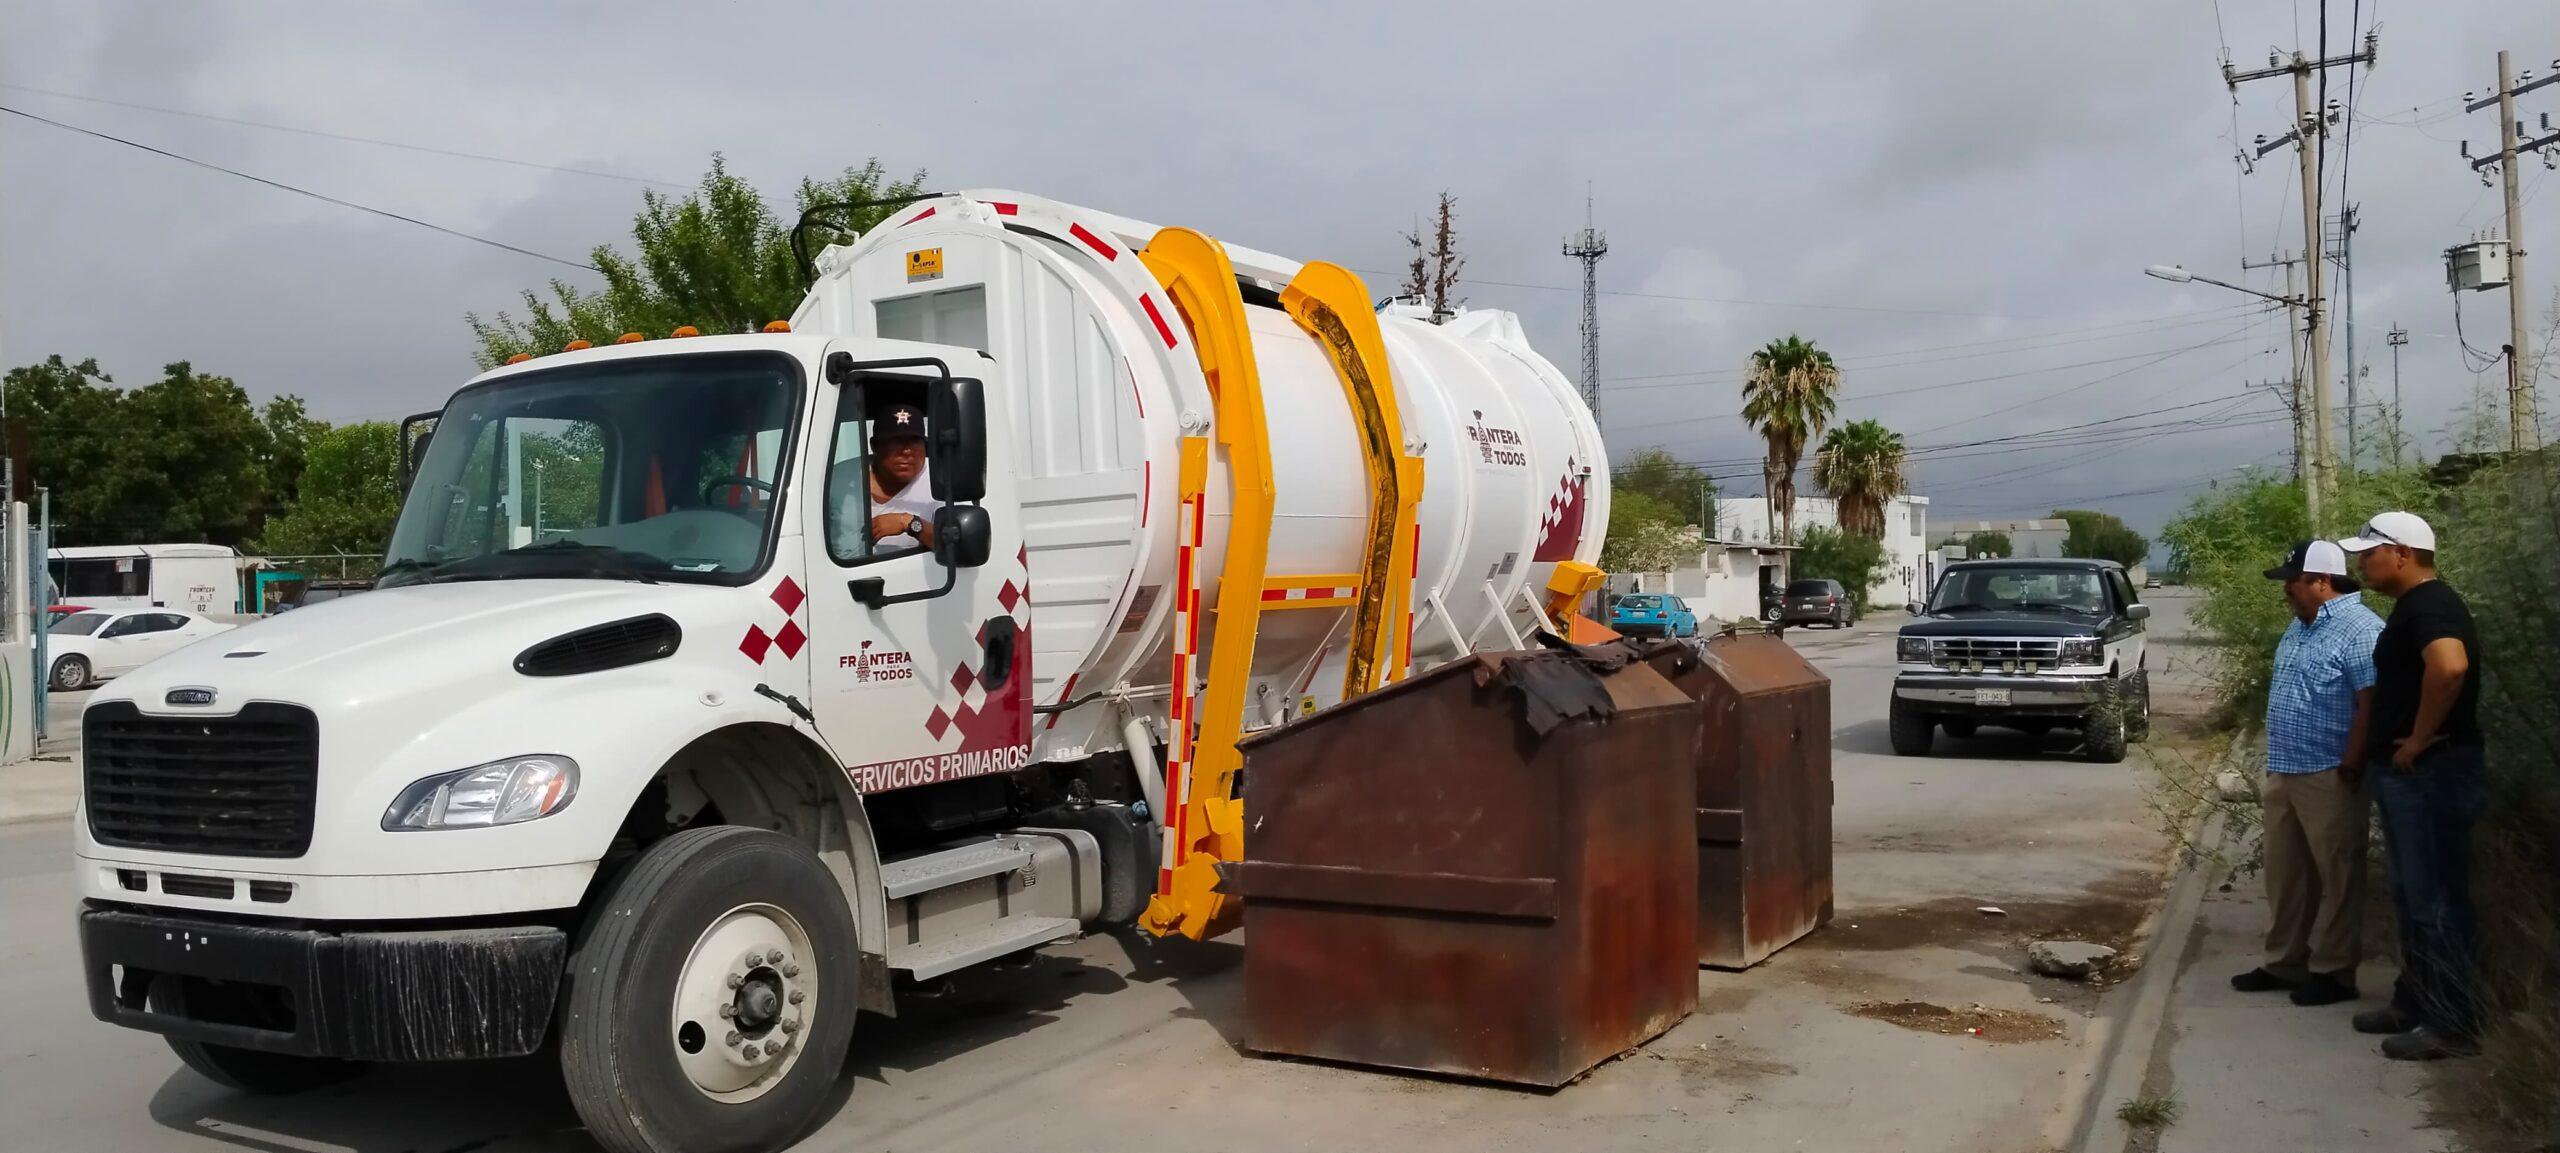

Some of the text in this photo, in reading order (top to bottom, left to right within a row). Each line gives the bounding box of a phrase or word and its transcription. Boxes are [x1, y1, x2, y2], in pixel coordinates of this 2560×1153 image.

[1466, 426, 1522, 445] RNTERA
[1494, 451, 1526, 466] TODOS
[197, 604, 206, 612] 02
[873, 668, 912, 681] TODOS
[851, 744, 1028, 792] ERVICIOS PRIMARIOS
